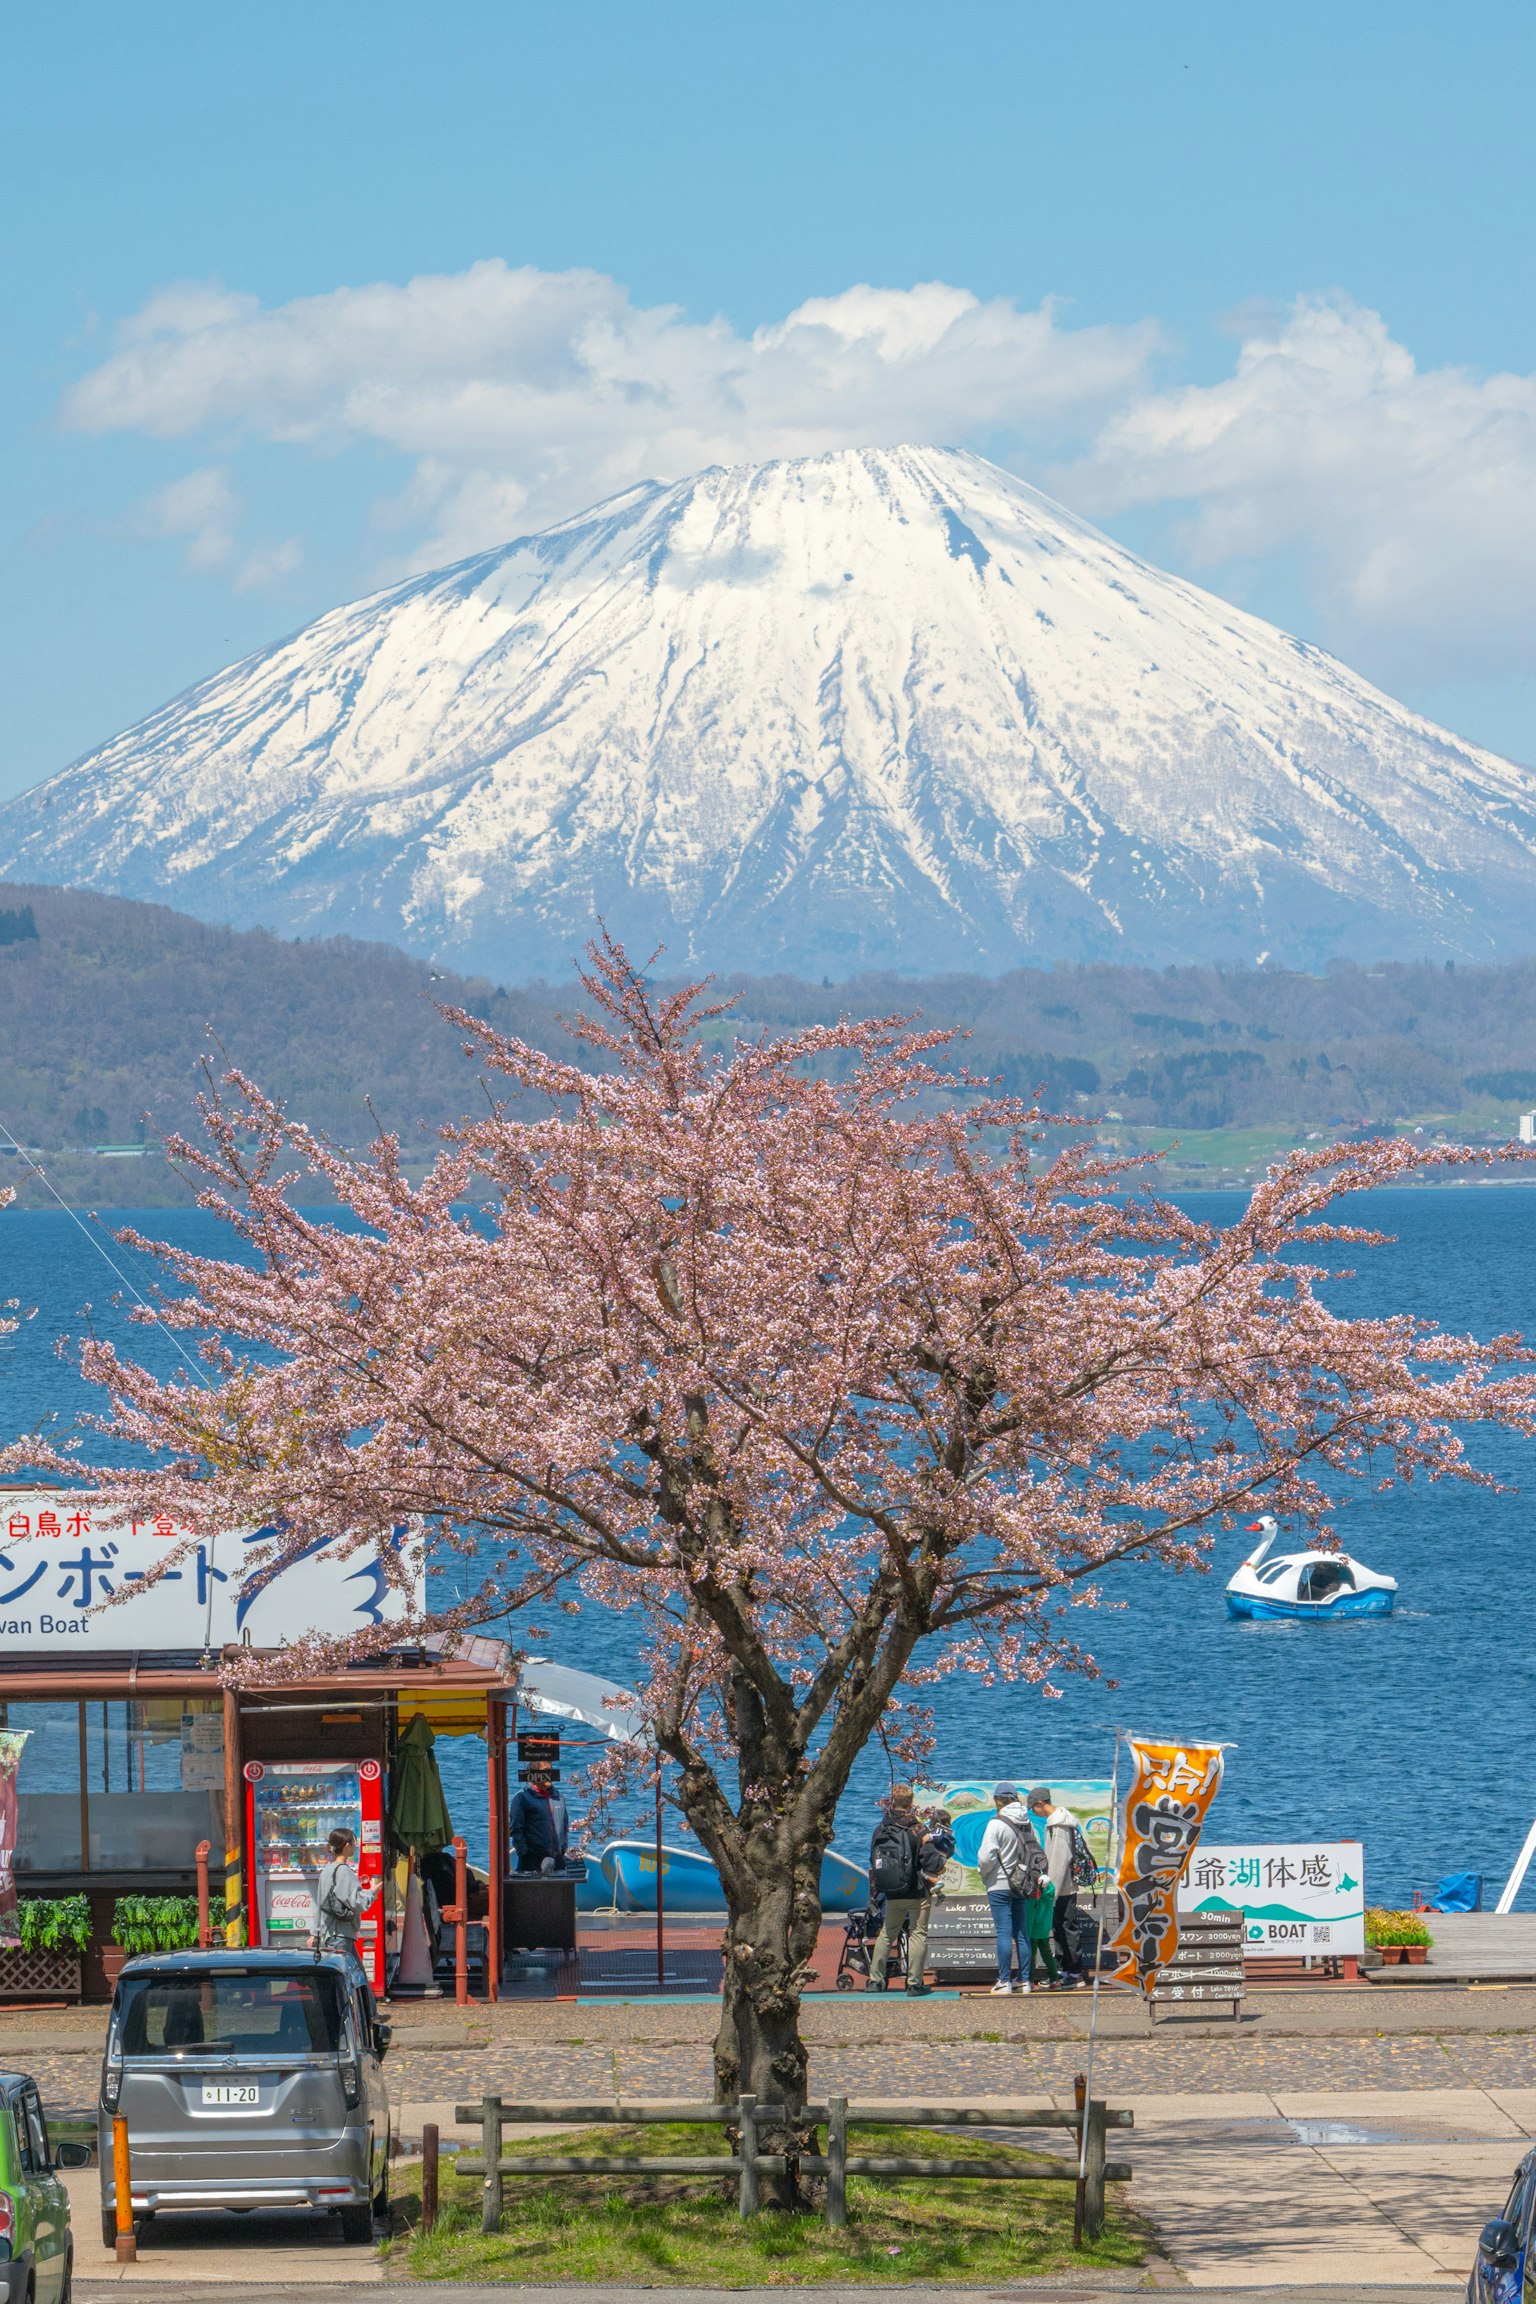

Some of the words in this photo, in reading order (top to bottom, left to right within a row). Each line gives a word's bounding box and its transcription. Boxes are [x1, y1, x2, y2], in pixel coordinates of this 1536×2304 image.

[40, 1615, 89, 1633] Boat
[526, 1772, 552, 1782] OPEN
[969, 1904, 992, 1912] TOY
[1075, 1903, 1093, 1911] oat
[1200, 1911, 1231, 1923] 30min
[1269, 1924, 1307, 1938] BOAT
[1180, 1933, 1203, 1941] スワン
[1178, 1951, 1203, 1960] ボート
[217, 2087, 256, 2102] 11-20
